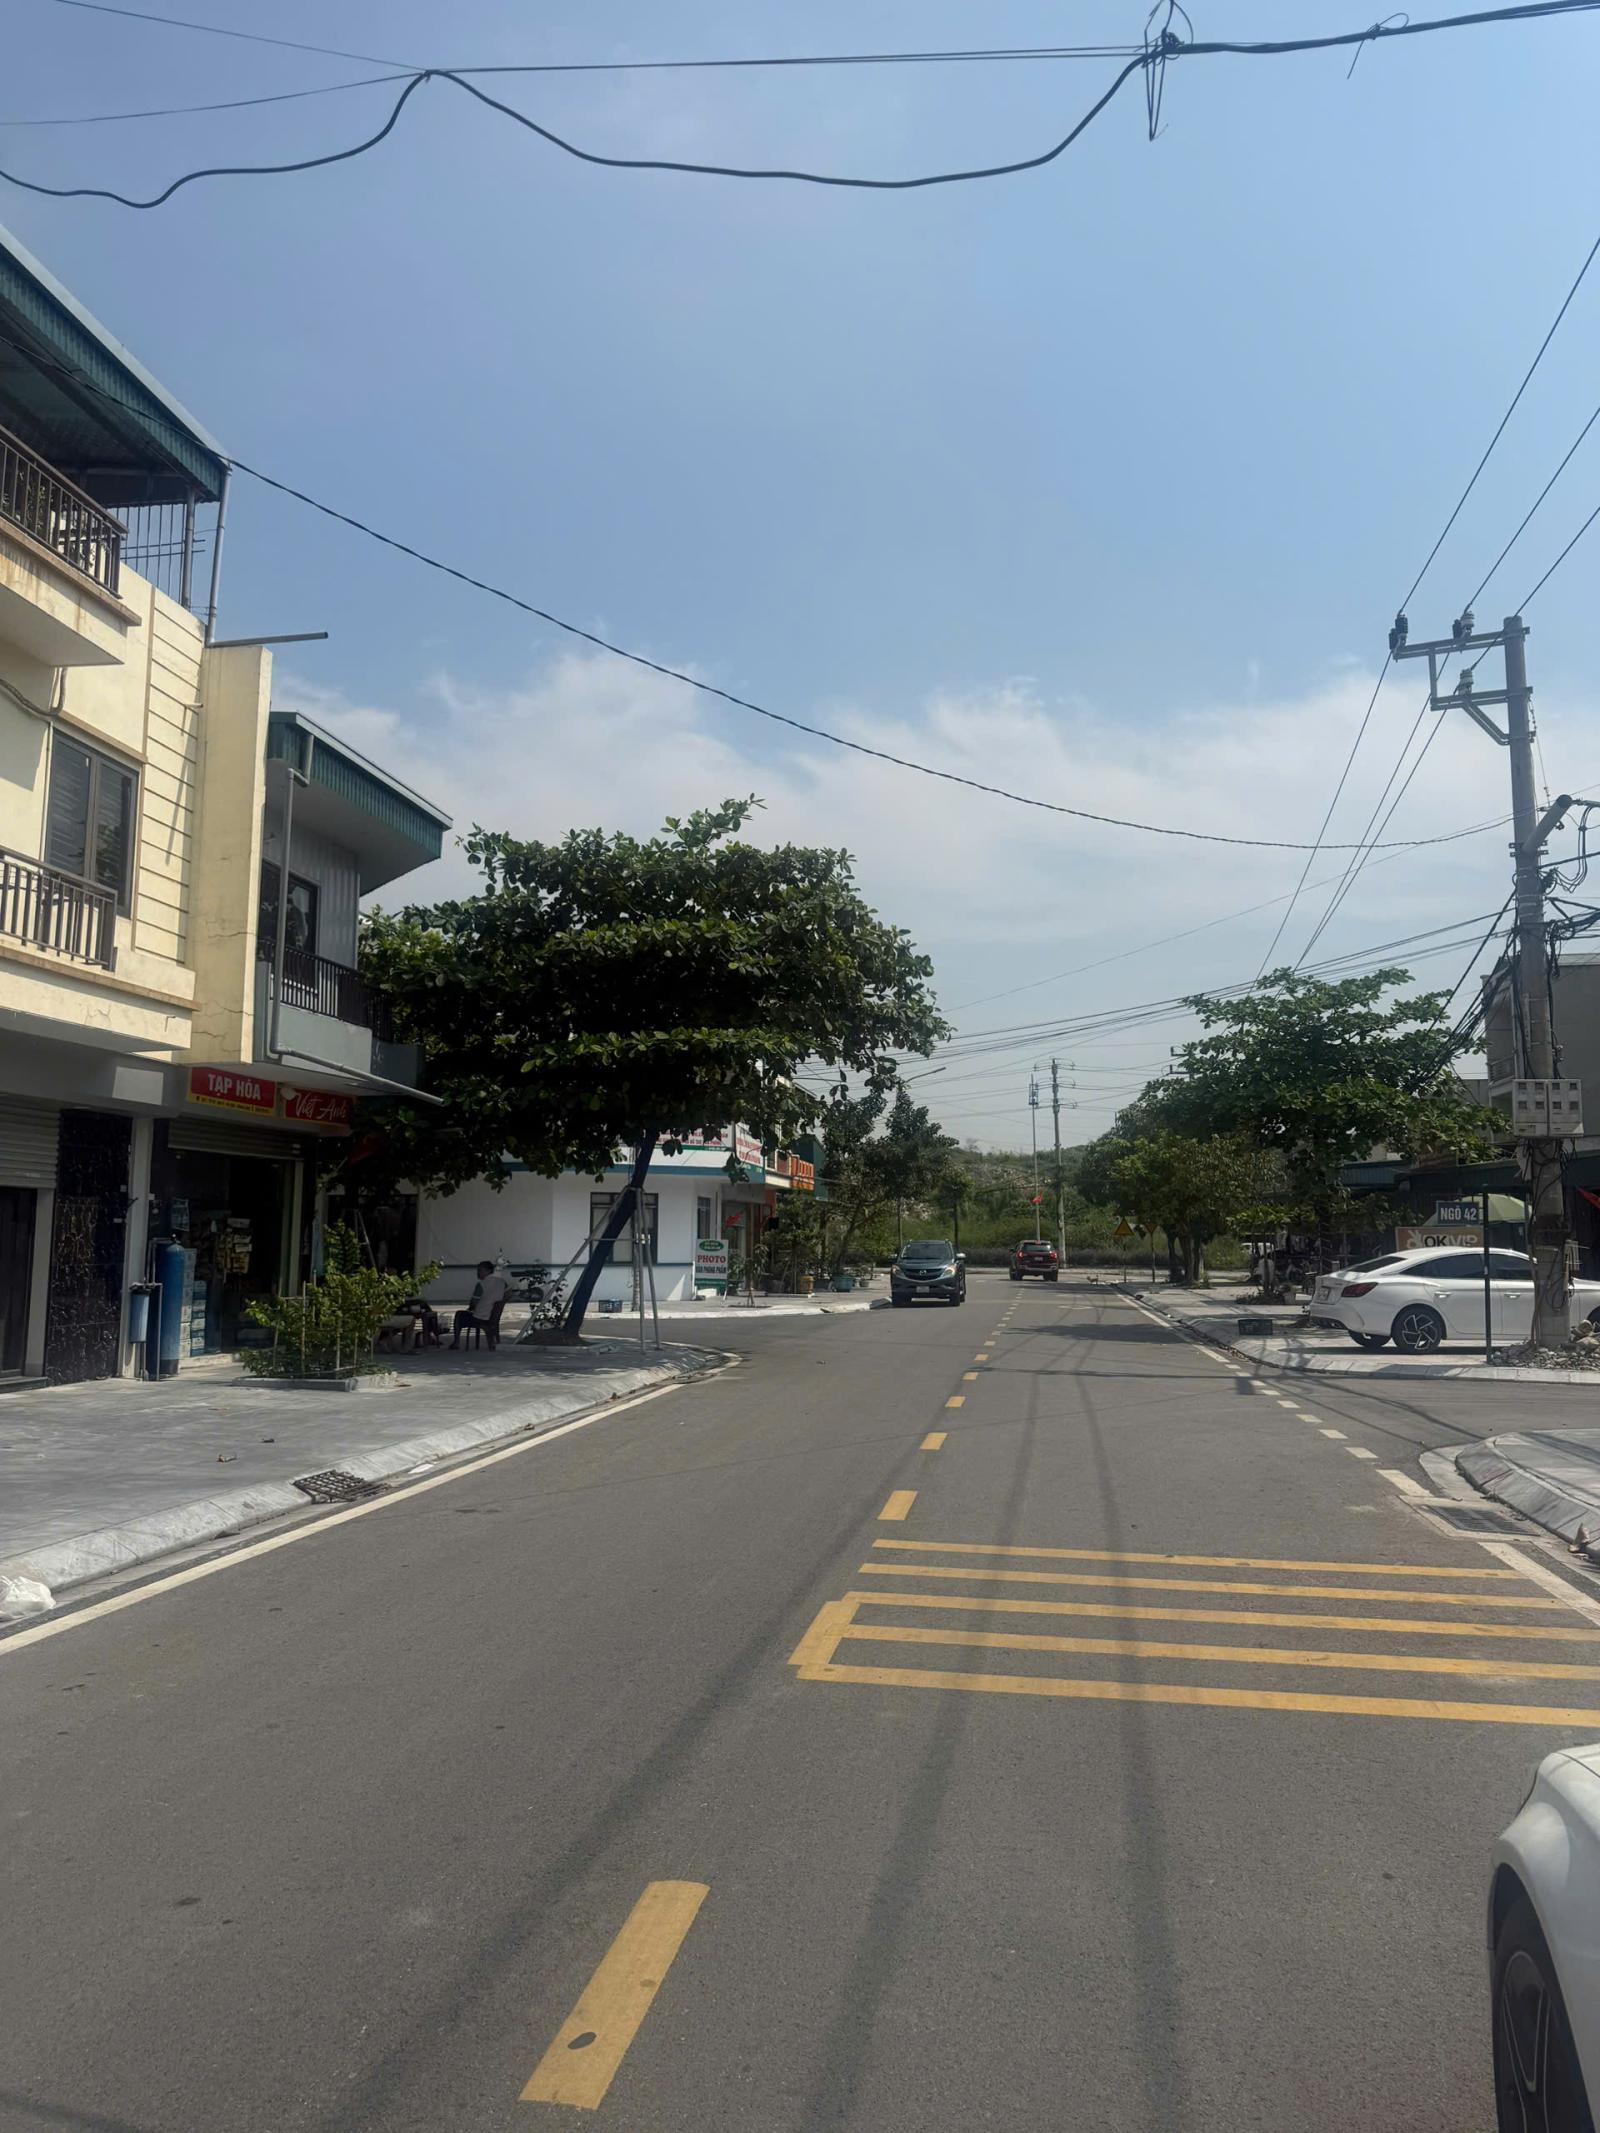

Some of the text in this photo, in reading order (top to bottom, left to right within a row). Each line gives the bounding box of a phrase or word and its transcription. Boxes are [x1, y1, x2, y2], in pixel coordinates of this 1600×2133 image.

[208, 1073, 233, 1097] TẠP
[1440, 1205, 1478, 1221] NGÕ 42
[697, 1255, 726, 1263] PHOTO
